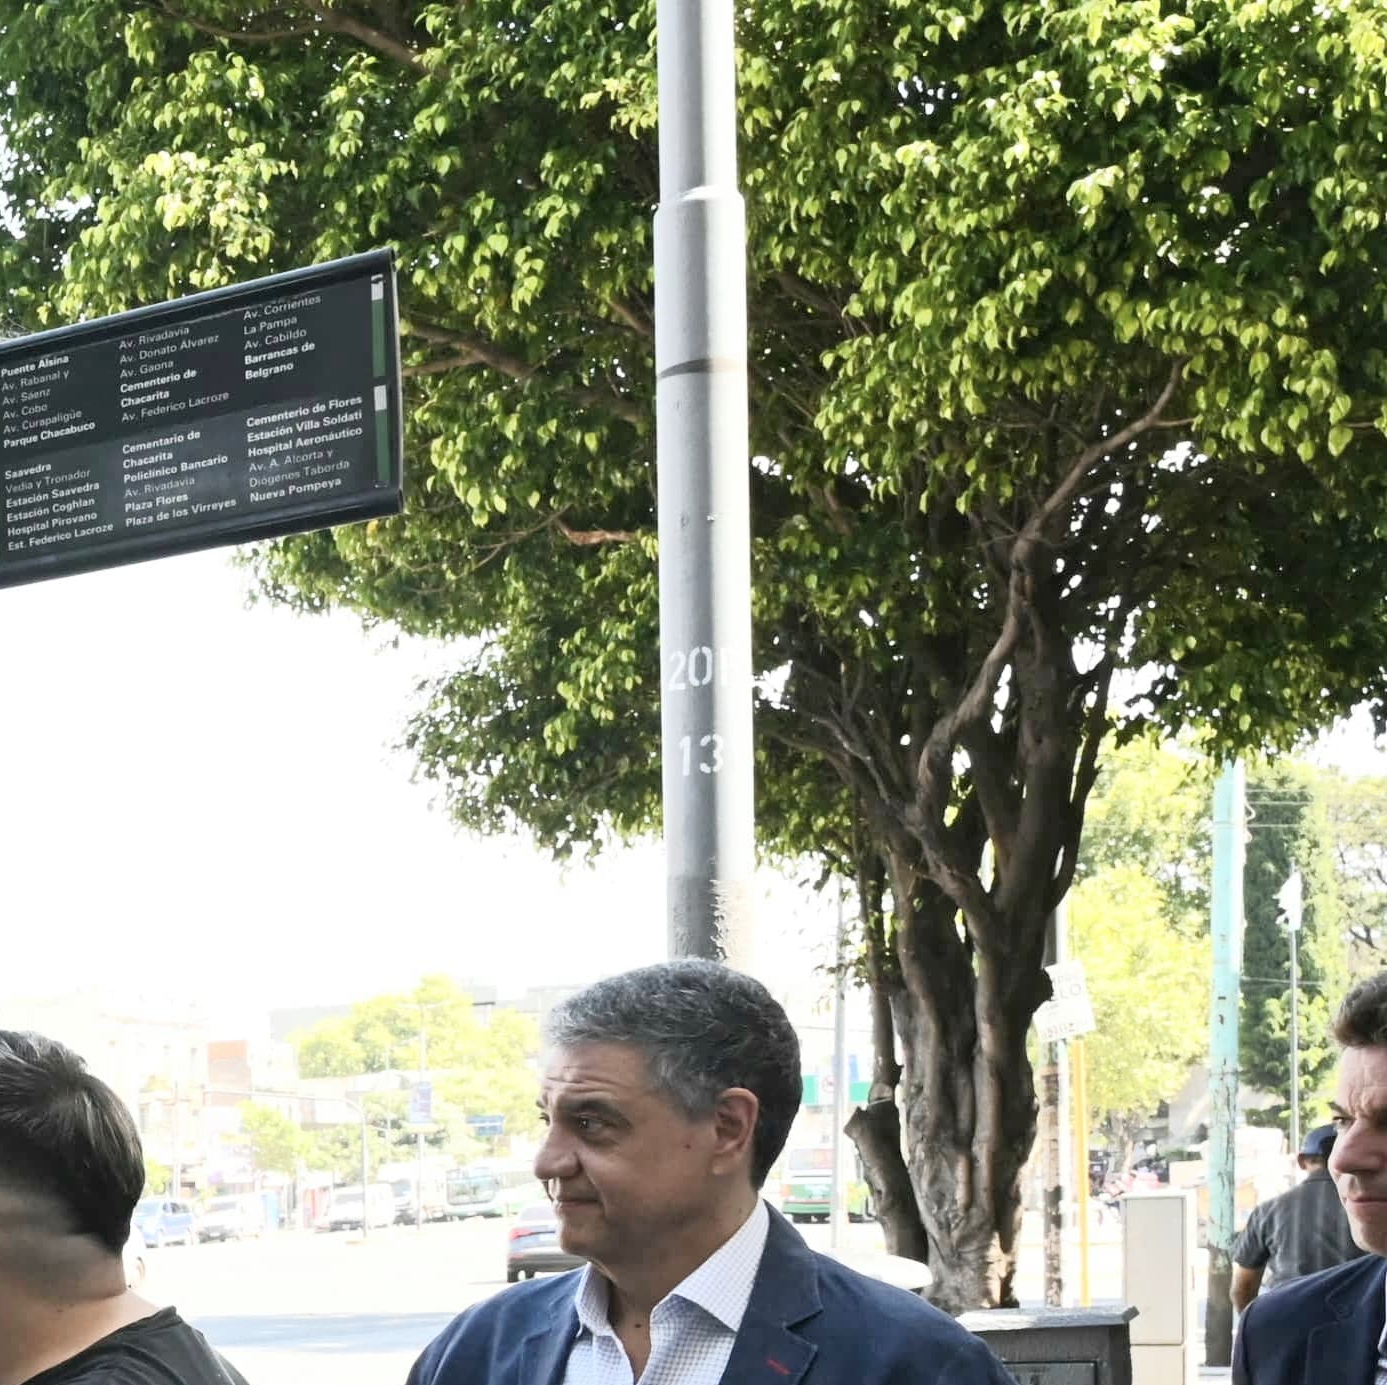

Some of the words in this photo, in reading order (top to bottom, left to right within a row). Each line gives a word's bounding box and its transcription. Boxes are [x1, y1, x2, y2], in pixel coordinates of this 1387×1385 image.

[264, 294, 321, 316] Corrientes
[138, 327, 190, 345] Rivadavia
[244, 325, 256, 335] La
[259, 316, 298, 332] Pampa
[265, 328, 307, 345] Cabildo
[139, 344, 177, 360] Donato
[244, 345, 299, 365] Barrancas
[301, 341, 316, 352] de
[0, 363, 36, 378] Puente
[38, 355, 69, 369] Alsina
[245, 362, 294, 380] Belgrano
[20, 370, 61, 388] Rabanal
[120, 372, 181, 393] Cementerio
[183, 368, 197, 379] de
[120, 390, 170, 408] Chacarita
[246, 407, 309, 428] Cementerio
[312, 402, 326, 413] de
[328, 395, 363, 410] Flores
[3, 435, 38, 449] Parque
[40, 422, 96, 440] Chacabuco
[187, 430, 201, 441] de
[247, 425, 293, 443] Estación
[296, 420, 320, 434] Villa
[323, 409, 363, 427] Soldati
[248, 440, 293, 457] Hospital
[122, 451, 173, 469] Chacarita
[180, 454, 228, 472] Bancario
[4, 463, 52, 480] Saavedra
[6, 493, 49, 509] Estación
[51, 481, 100, 499] Saavedra
[250, 488, 286, 503] Nueva
[288, 477, 342, 496] Pompeya
[6, 507, 49, 523] Estación
[52, 498, 95, 514] Coghlan
[125, 500, 153, 513] Plaza
[155, 493, 189, 507] Flores
[125, 515, 153, 528] Plaza
[156, 511, 170, 521] de
[172, 508, 189, 519] los
[191, 498, 237, 515] Virreyes
[7, 520, 49, 537] Hospital
[51, 512, 98, 529] Pirovano
[29, 531, 72, 548] Federico
[74, 523, 114, 538] Lacroze
[679, 733, 724, 777] 13
